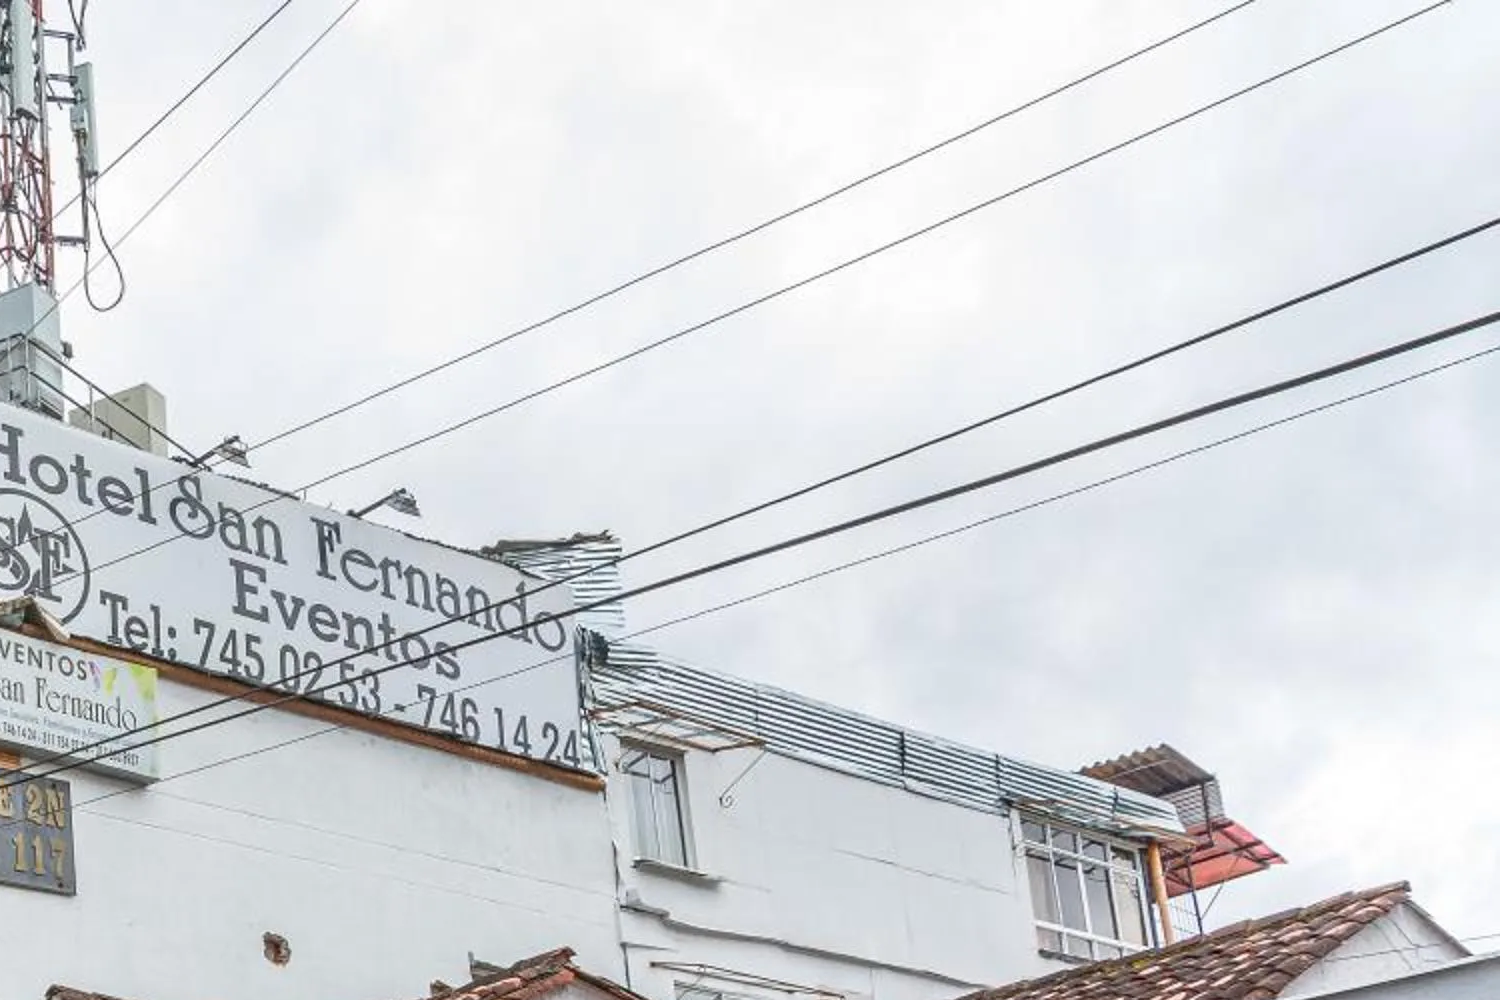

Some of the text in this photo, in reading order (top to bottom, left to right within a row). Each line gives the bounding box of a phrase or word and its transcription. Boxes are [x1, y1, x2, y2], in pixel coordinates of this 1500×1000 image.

[169, 476, 288, 567] San
[310, 515, 566, 653] Fernando
[229, 557, 461, 680] Eventos
[36, 677, 137, 732] Fernando
[100, 588, 180, 662] Tel:
[194, 619, 264, 679] 745
[279, 648, 323, 699] 02
[338, 662, 381, 716] 53
[416, 685, 481, 746] 746
[494, 707, 532, 760] 14
[541, 724, 583, 770] 24
[24, 783, 67, 829] 2N
[12, 831, 67, 881] 117
